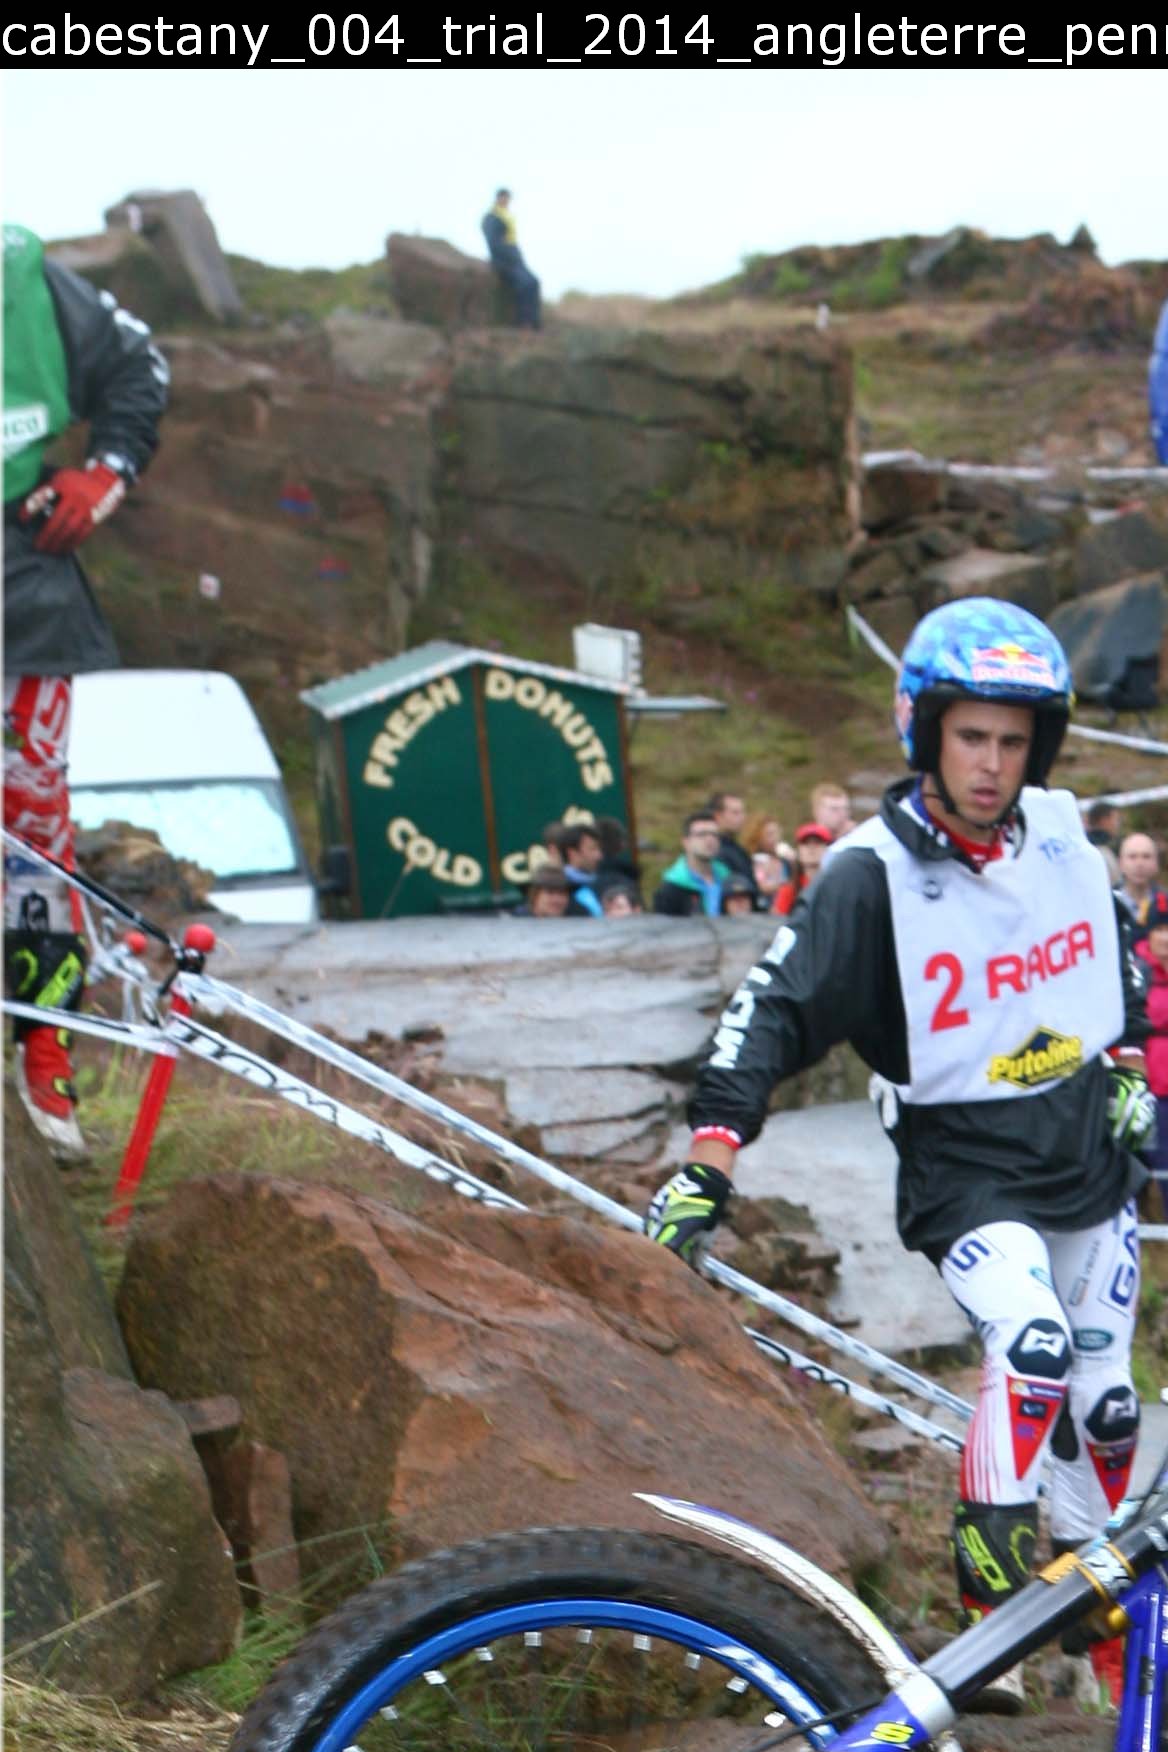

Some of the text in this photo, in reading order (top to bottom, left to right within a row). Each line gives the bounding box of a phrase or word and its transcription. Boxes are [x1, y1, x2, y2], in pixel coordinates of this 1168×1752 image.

[363, 668, 614, 793] FRESH DONUTS
[387, 816, 483, 887] COLD
[923, 920, 1096, 1034] 2 RAGA
[986, 1035, 1083, 1085] Putoline
